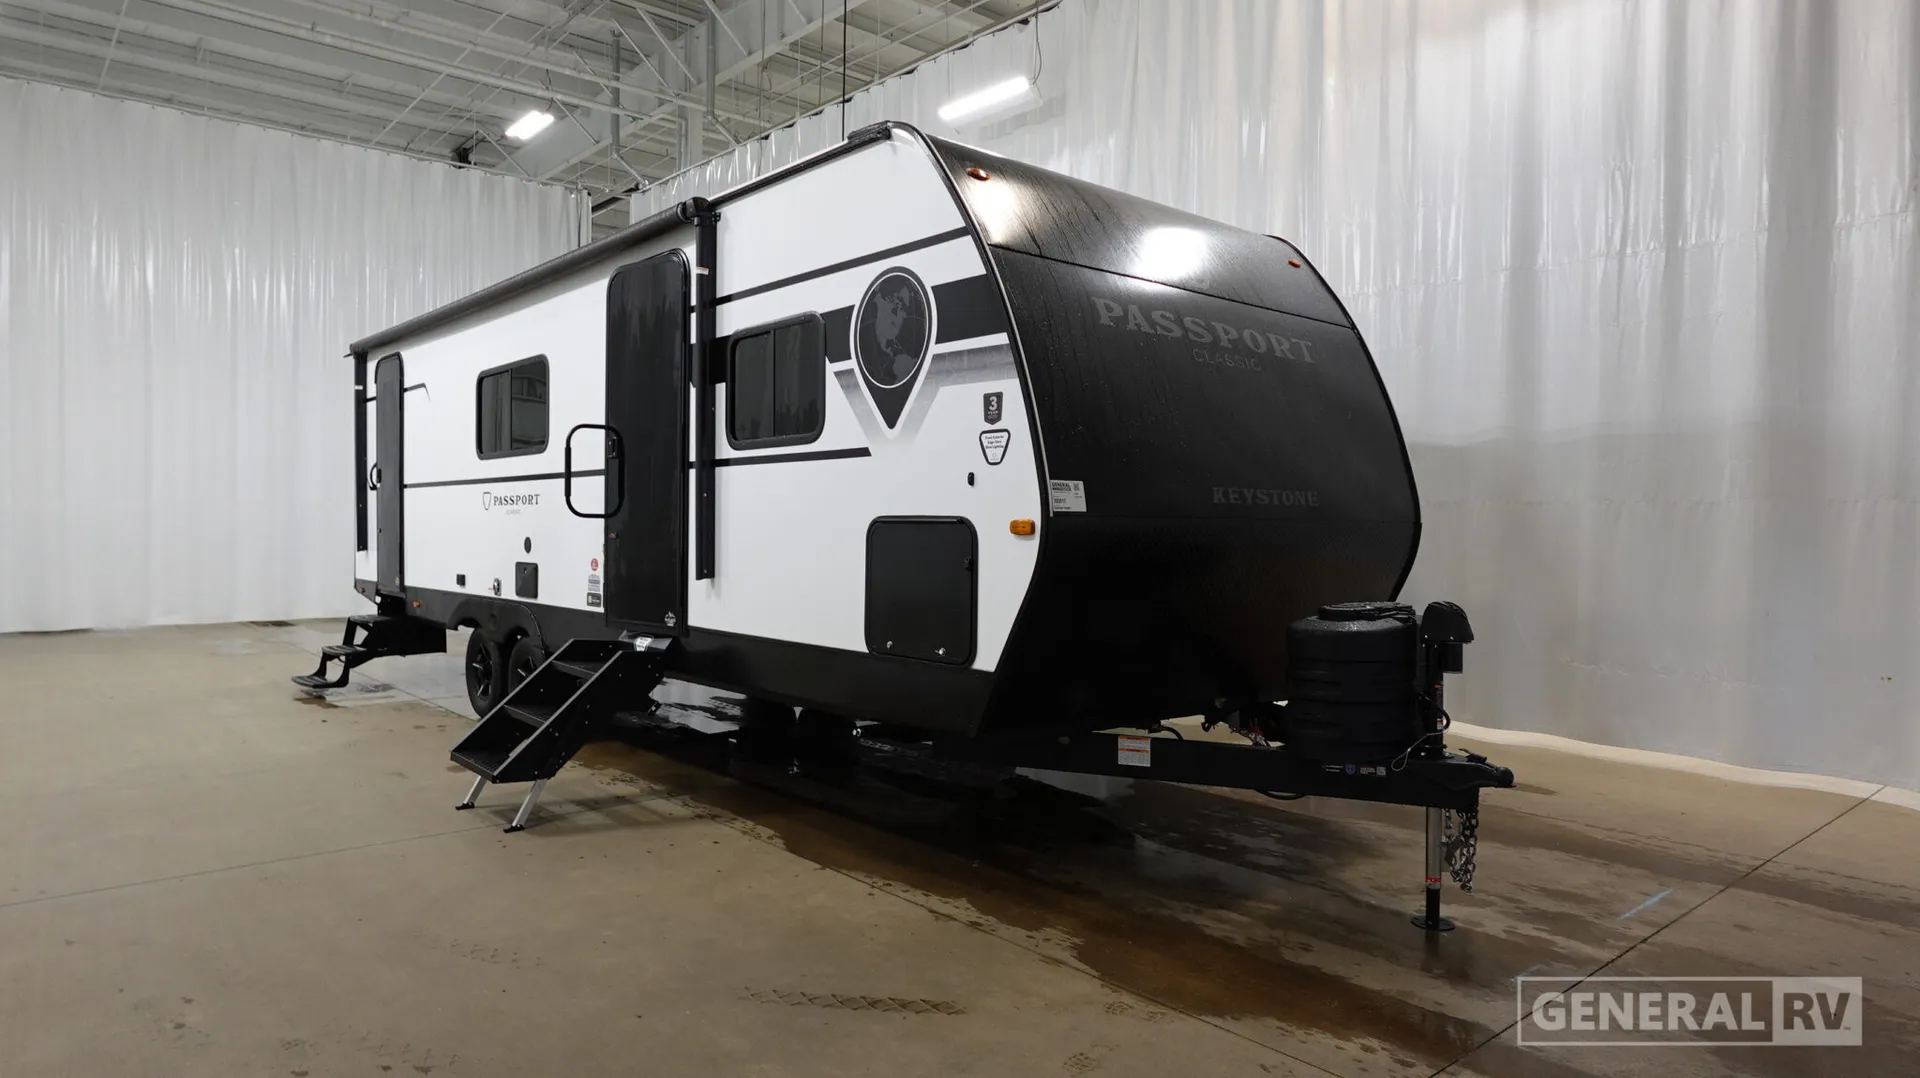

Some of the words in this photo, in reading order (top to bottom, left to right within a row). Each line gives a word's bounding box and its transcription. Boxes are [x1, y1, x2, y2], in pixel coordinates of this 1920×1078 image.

[1092, 297, 1316, 364] PASSPORT
[1192, 348, 1262, 372] CLASSIC
[989, 396, 998, 411] 3
[493, 493, 541, 506] PASSPORT
[1211, 486, 1320, 507] KEYSTONE
